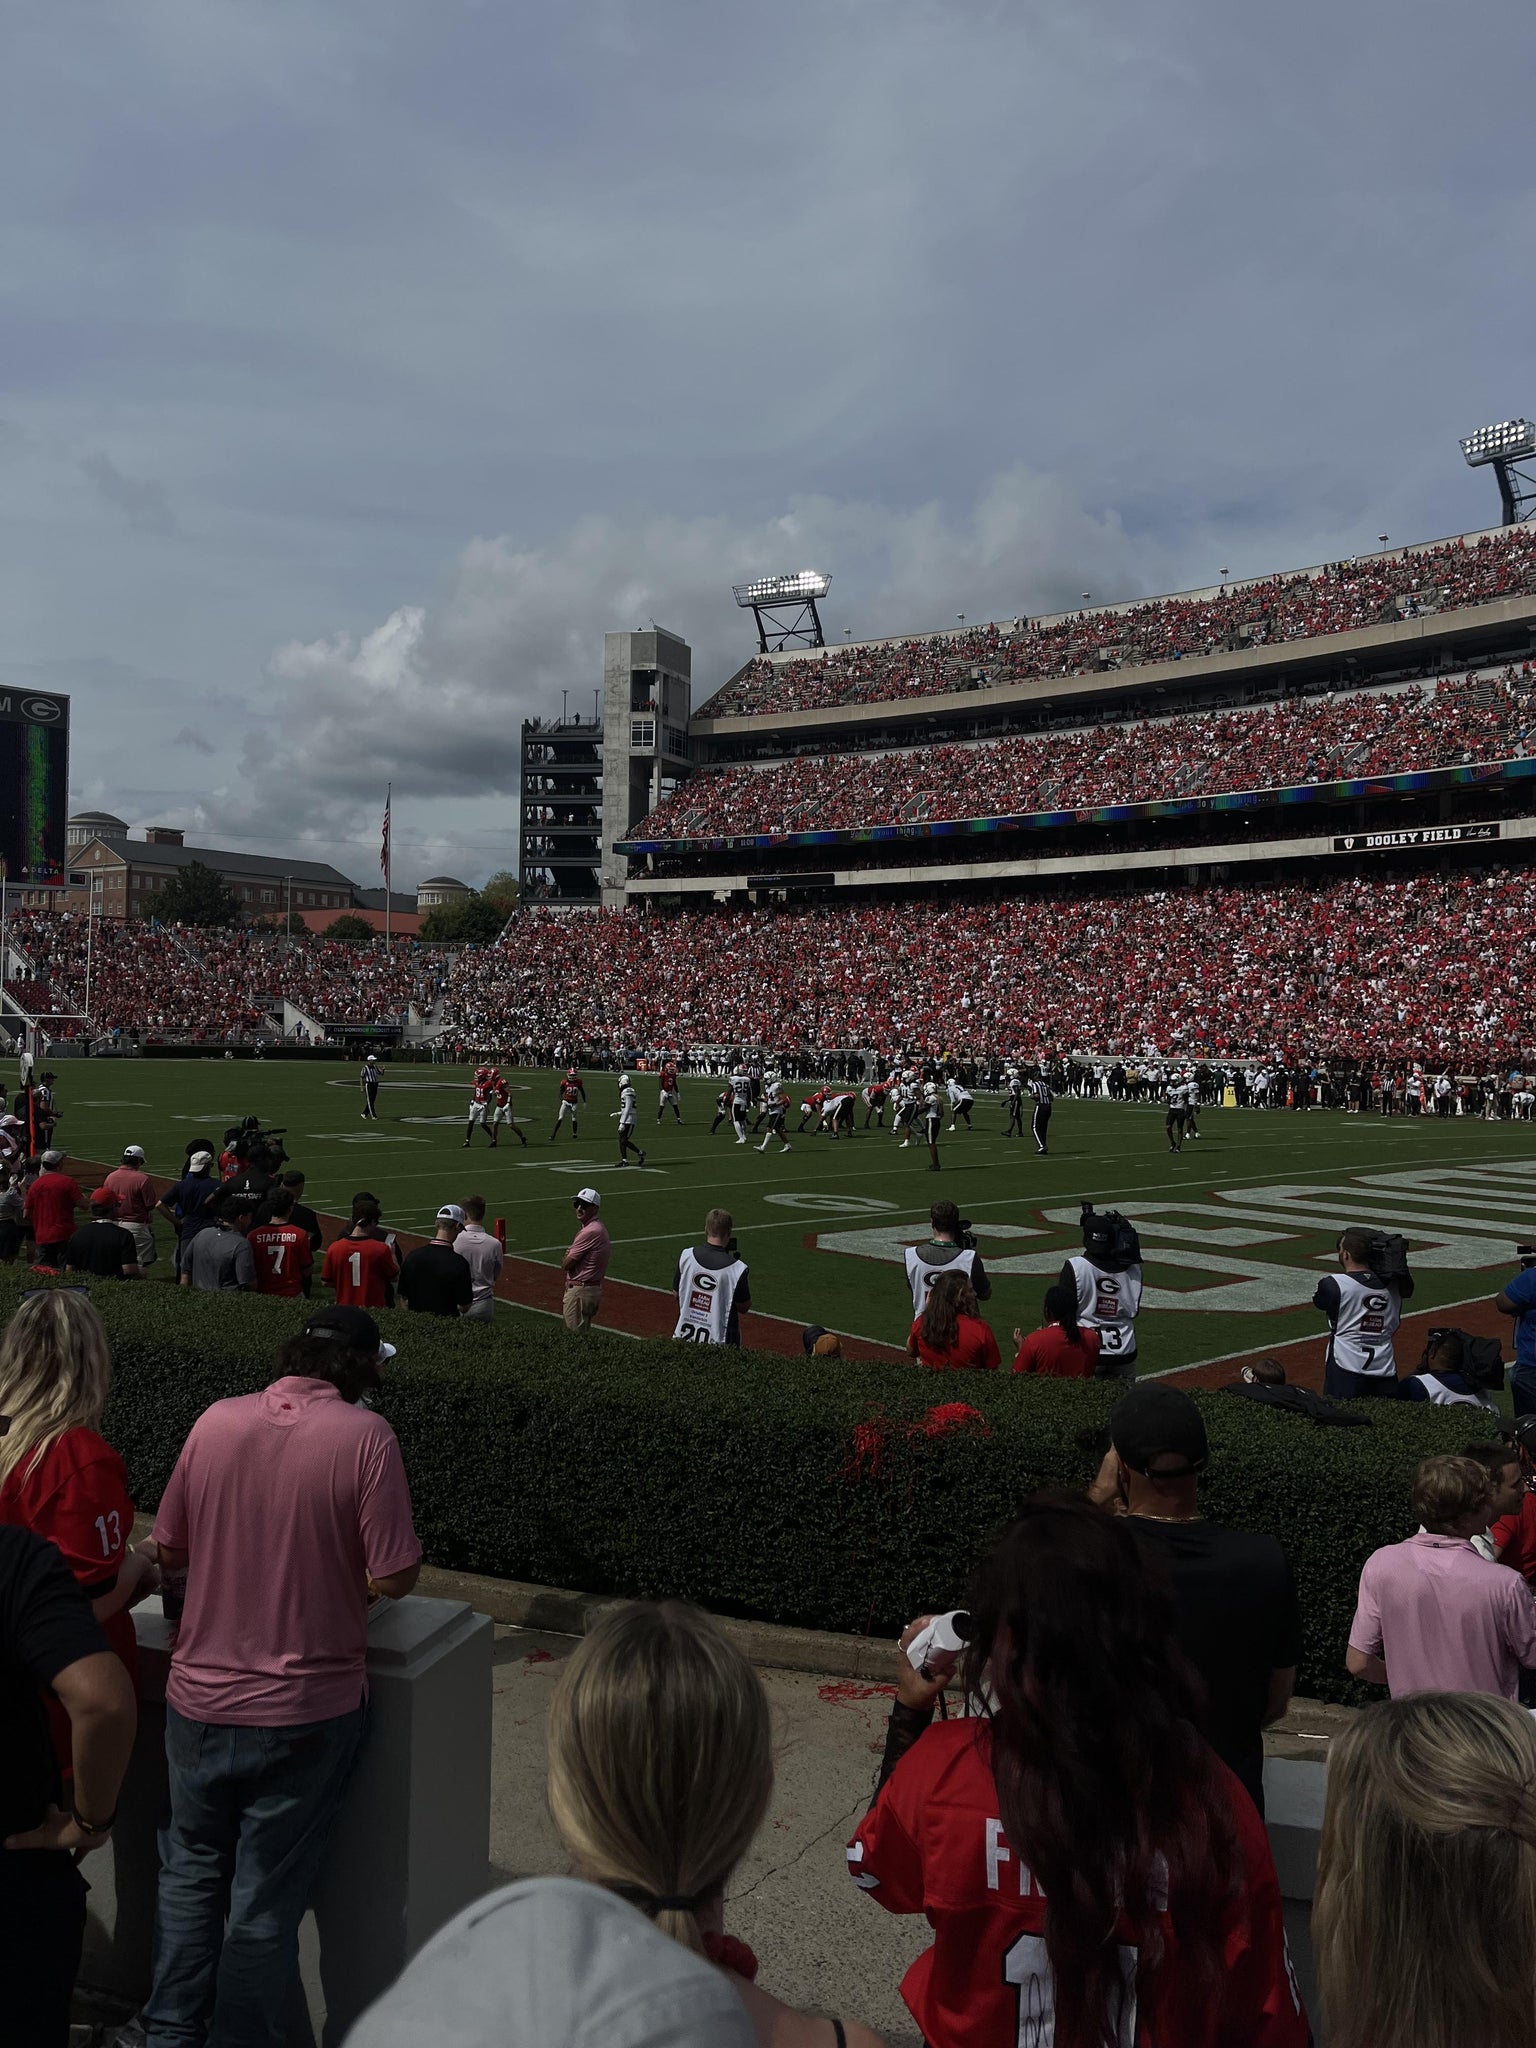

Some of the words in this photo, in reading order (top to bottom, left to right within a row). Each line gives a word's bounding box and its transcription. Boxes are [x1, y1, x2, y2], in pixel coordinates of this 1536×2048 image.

[1366, 833, 1419, 847] DOOLEY
[1422, 828, 1462, 842] FIELD
[31, 866, 59, 875] DELTA
[566, 1086, 578, 1096] 20
[735, 1081, 749, 1094] 29
[256, 1232, 297, 1244] STAFFORD
[267, 1245, 285, 1275] 7
[348, 1252, 361, 1287] 1
[680, 1323, 710, 1342] 20
[1362, 1347, 1375, 1370] 7
[95, 1510, 120, 1557] 13
